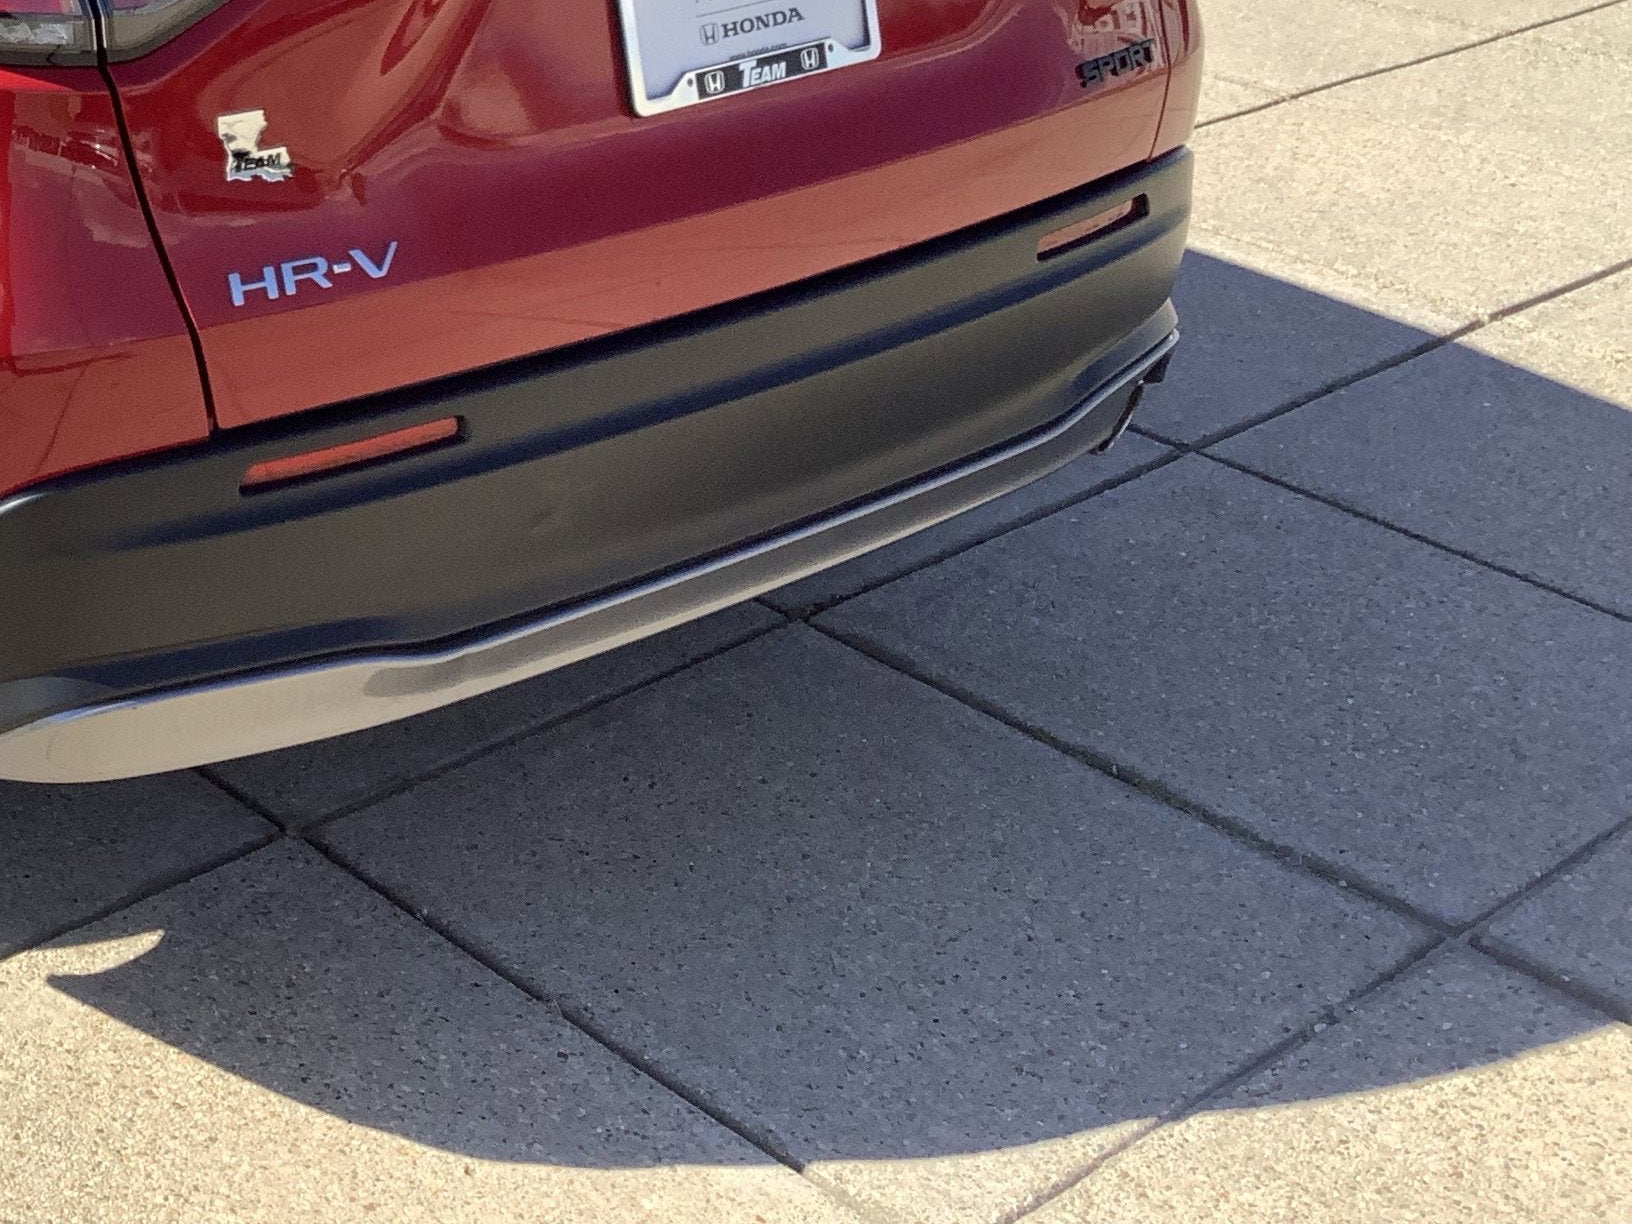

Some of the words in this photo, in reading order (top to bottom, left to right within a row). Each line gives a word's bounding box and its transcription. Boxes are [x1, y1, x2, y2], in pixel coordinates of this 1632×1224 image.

[722, 7, 805, 39] HONDA
[739, 59, 787, 88] TEAM
[1075, 38, 1155, 88] SPORT
[232, 150, 282, 173] TEAM
[228, 241, 399, 308] HR-V
